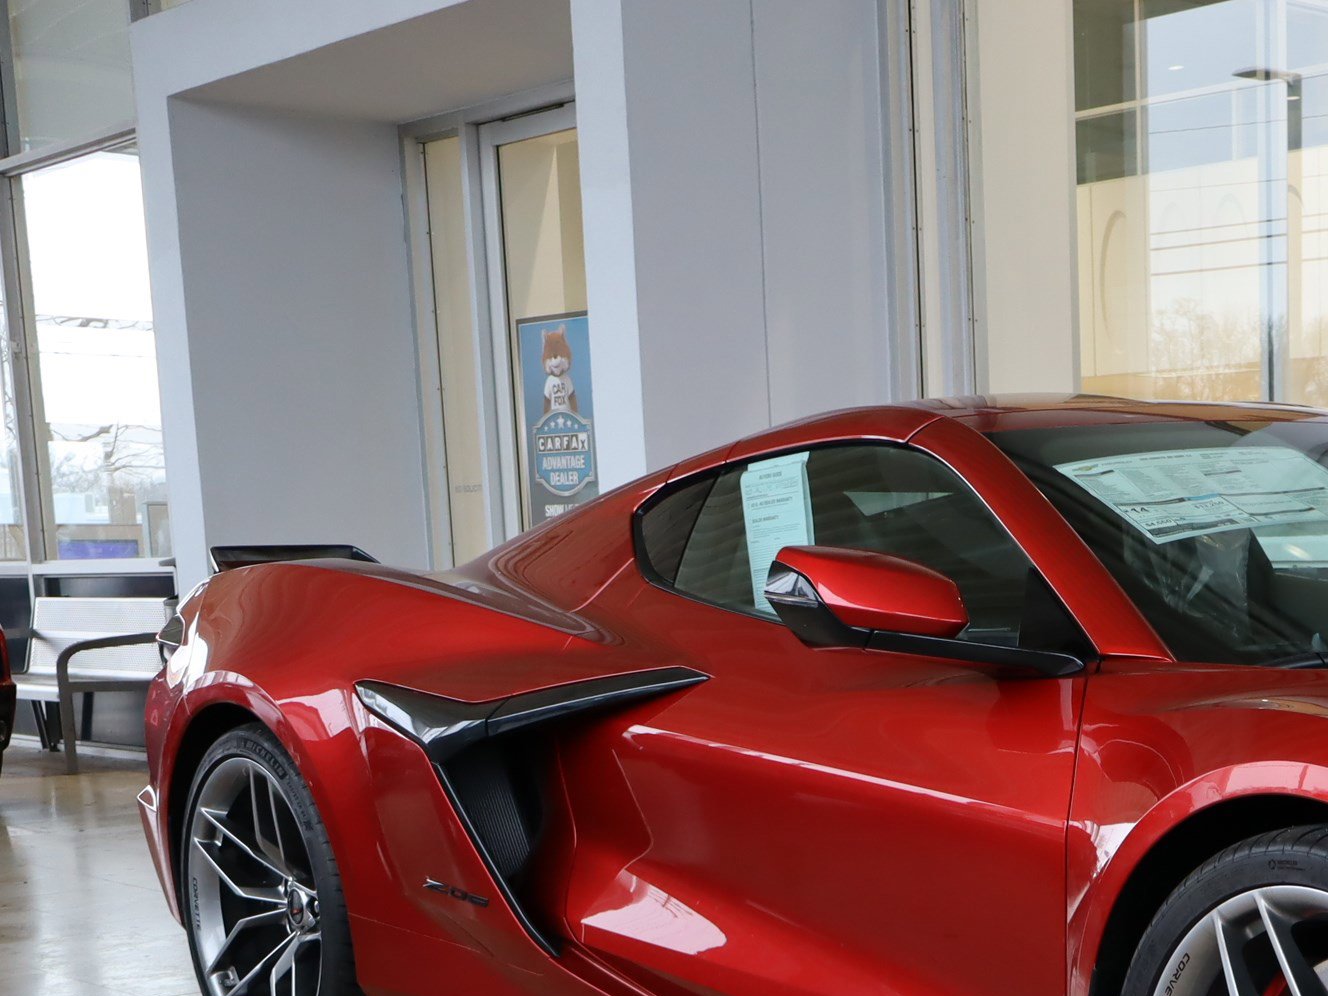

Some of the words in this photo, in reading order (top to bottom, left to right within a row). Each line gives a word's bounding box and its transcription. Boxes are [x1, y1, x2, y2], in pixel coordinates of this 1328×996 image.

[552, 383, 567, 395] CAR
[553, 396, 567, 407] FOX
[537, 434, 588, 452] CARFAX
[542, 455, 586, 471] ADVANTAGE
[550, 471, 579, 486] DEALER
